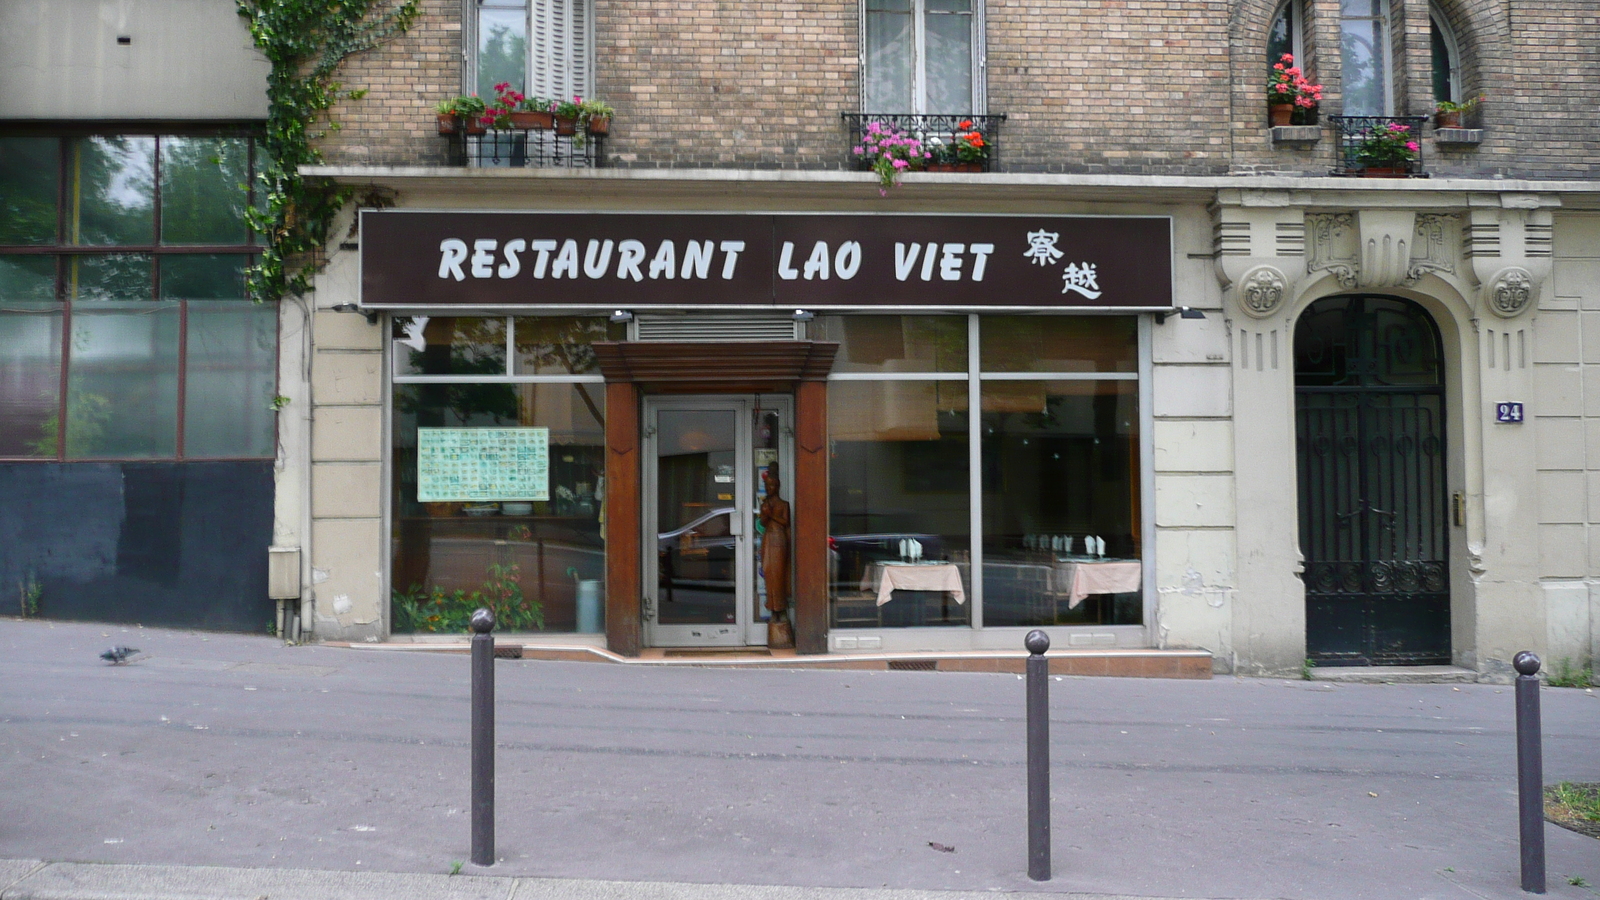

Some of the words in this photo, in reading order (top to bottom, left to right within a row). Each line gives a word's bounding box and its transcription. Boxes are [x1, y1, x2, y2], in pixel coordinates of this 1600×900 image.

[438, 238, 746, 282] RESTAURANT
[777, 240, 863, 281] LAO
[894, 242, 996, 282] VIET
[1500, 404, 1520, 420] 24
